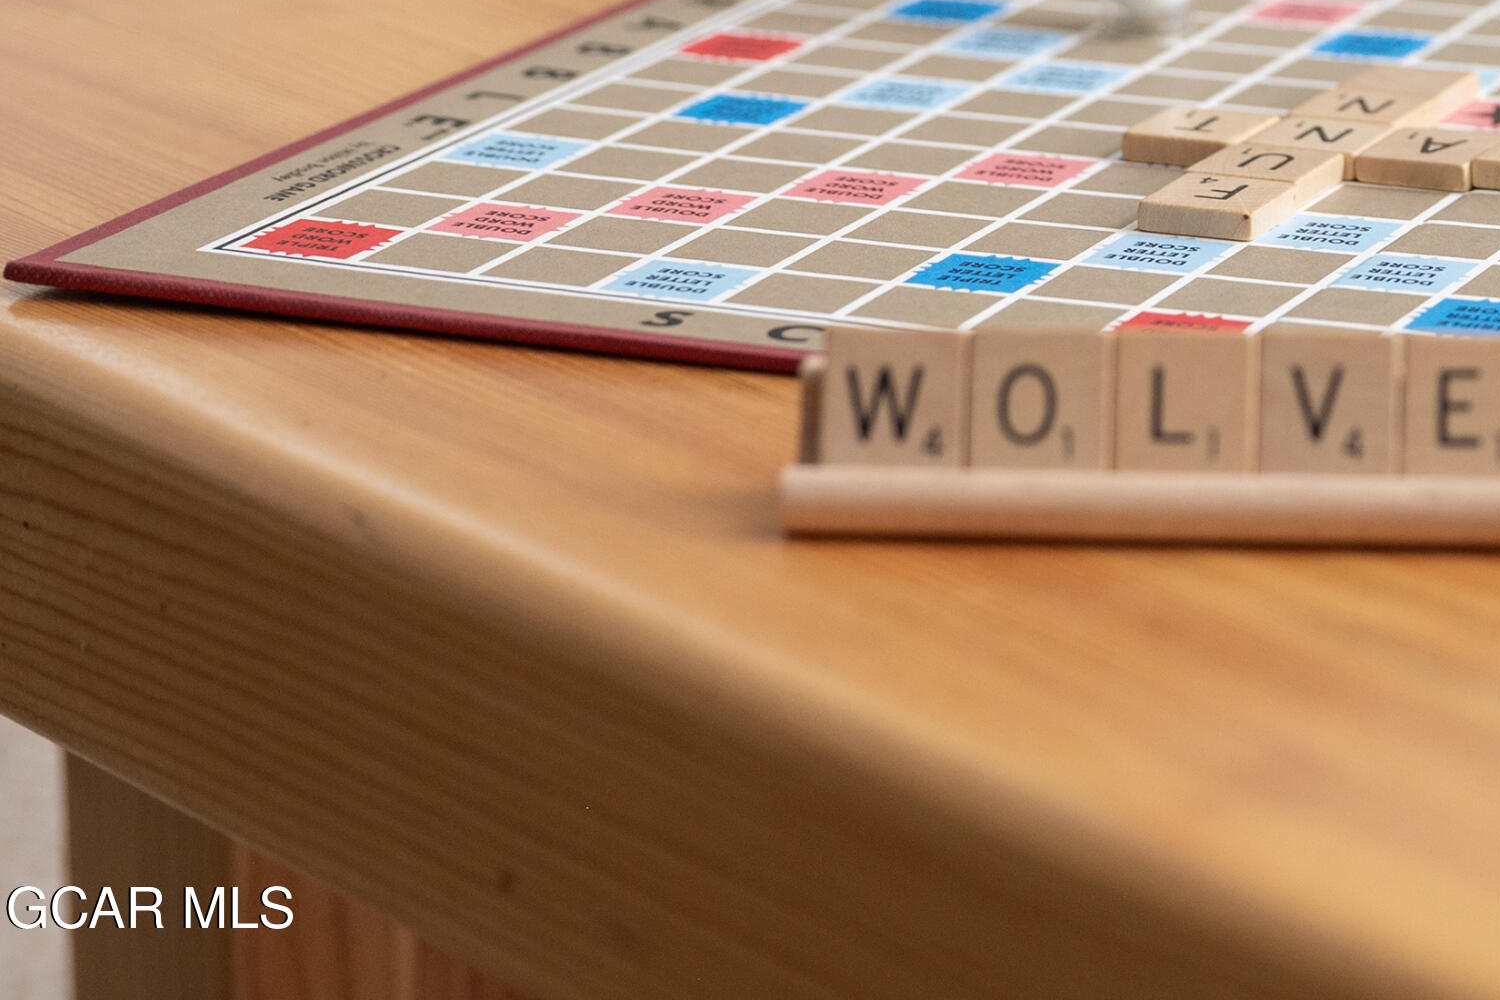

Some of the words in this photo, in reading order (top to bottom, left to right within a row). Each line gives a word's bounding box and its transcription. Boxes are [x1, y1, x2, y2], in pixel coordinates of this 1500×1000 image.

[835, 176, 898, 187] SCORE
[825, 182, 884, 193] WORD
[661, 194, 728, 204] SCORE
[804, 187, 883, 200] DOUBLE
[652, 200, 712, 210] WORD
[485, 211, 550, 221] SCORE
[630, 205, 710, 217] DOUBLE
[475, 216, 534, 227] WORD
[1305, 222, 1372, 232] SCORE
[303, 227, 368, 238] SCORE
[451, 222, 532, 235] DOUBLE
[1296, 228, 1362, 239] LETTER
[292, 234, 352, 245] WORD
[1277, 233, 1359, 246] DOUBLE
[277, 240, 338, 251] TRIPLE
[1133, 241, 1201, 252] SCORE
[1124, 248, 1190, 258] LETTER
[1104, 254, 1187, 266] DOUBLE
[959, 261, 1028, 272] SCORE
[1378, 261, 1447, 272] SCORE
[658, 268, 726, 279] SCORE
[948, 267, 1016, 279] LETTER
[1369, 268, 1437, 279] LETTER
[645, 275, 712, 286] LETTER
[937, 274, 1001, 285] TRIPLE
[1350, 273, 1434, 287] DOUBLE
[625, 280, 708, 294] DOUBLE
